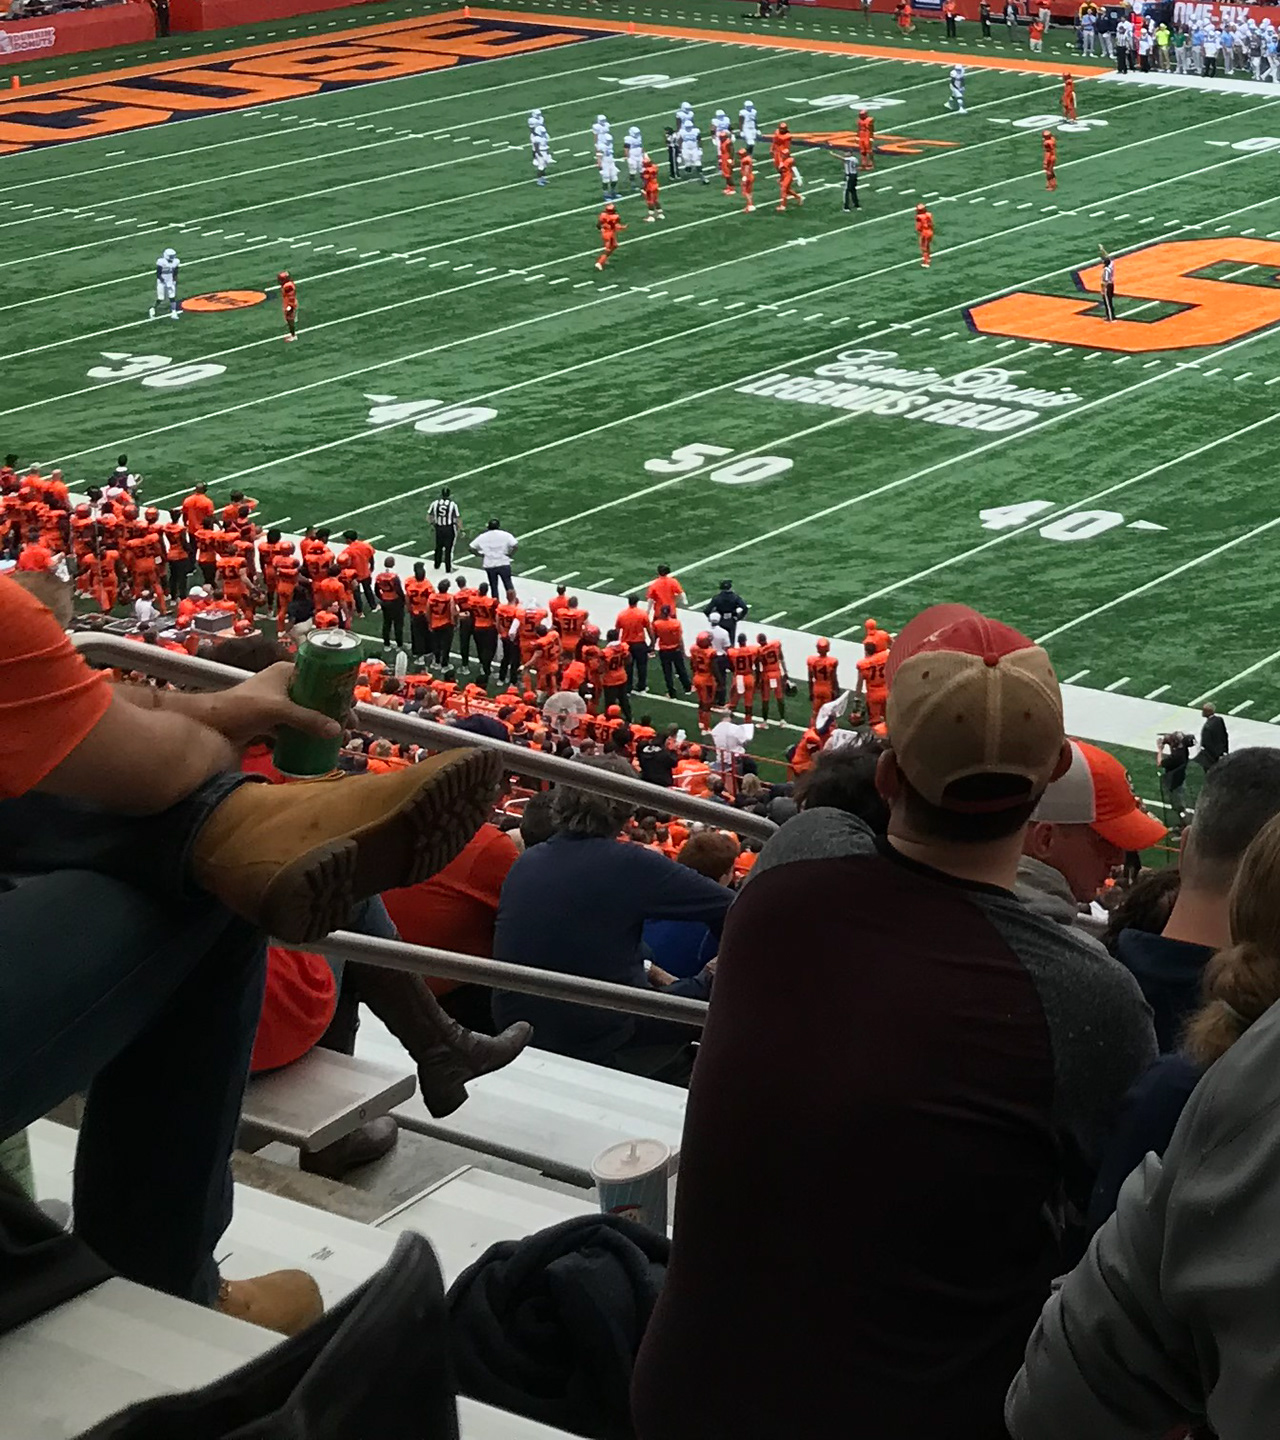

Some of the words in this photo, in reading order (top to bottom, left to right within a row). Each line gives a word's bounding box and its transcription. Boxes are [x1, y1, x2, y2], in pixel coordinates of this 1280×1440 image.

[14, 39, 54, 49] DONUTS
[86, 352, 228, 389] 30
[366, 397, 499, 434] 40
[734, 372, 920, 418] LEGENDS
[904, 393, 1041, 433] FIELD
[643, 443, 796, 486] 50
[978, 499, 1126, 543] 40
